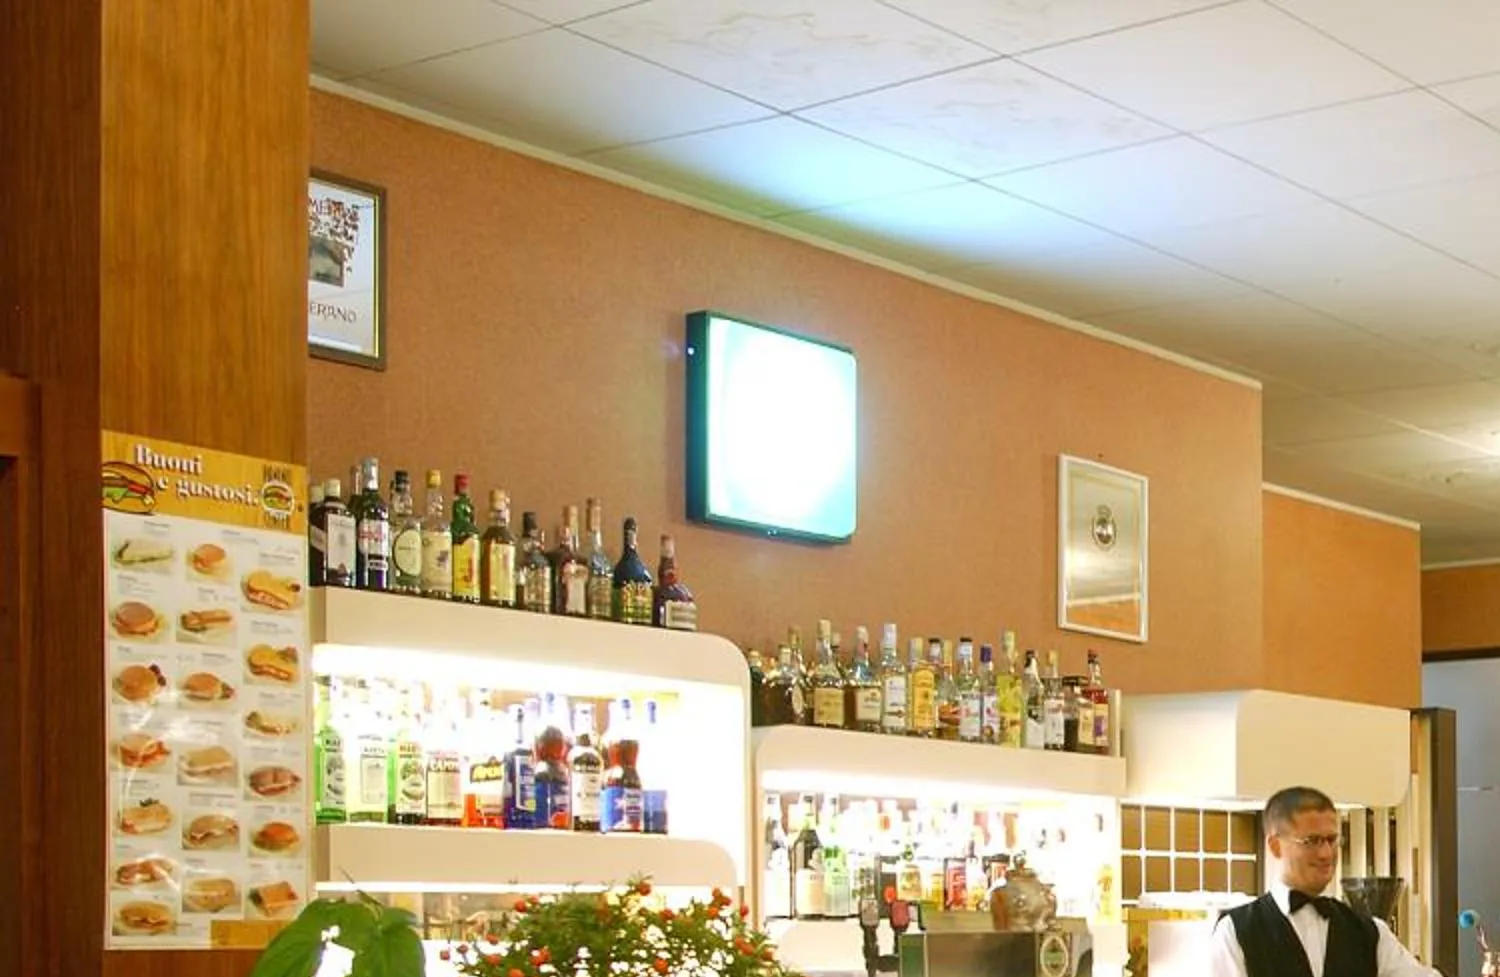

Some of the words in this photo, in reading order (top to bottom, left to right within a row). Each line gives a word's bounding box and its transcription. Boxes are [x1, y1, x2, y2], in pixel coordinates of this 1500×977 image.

[309, 302, 357, 323] ERANO
[134, 444, 204, 474] Buoni
[156, 474, 169, 491] e
